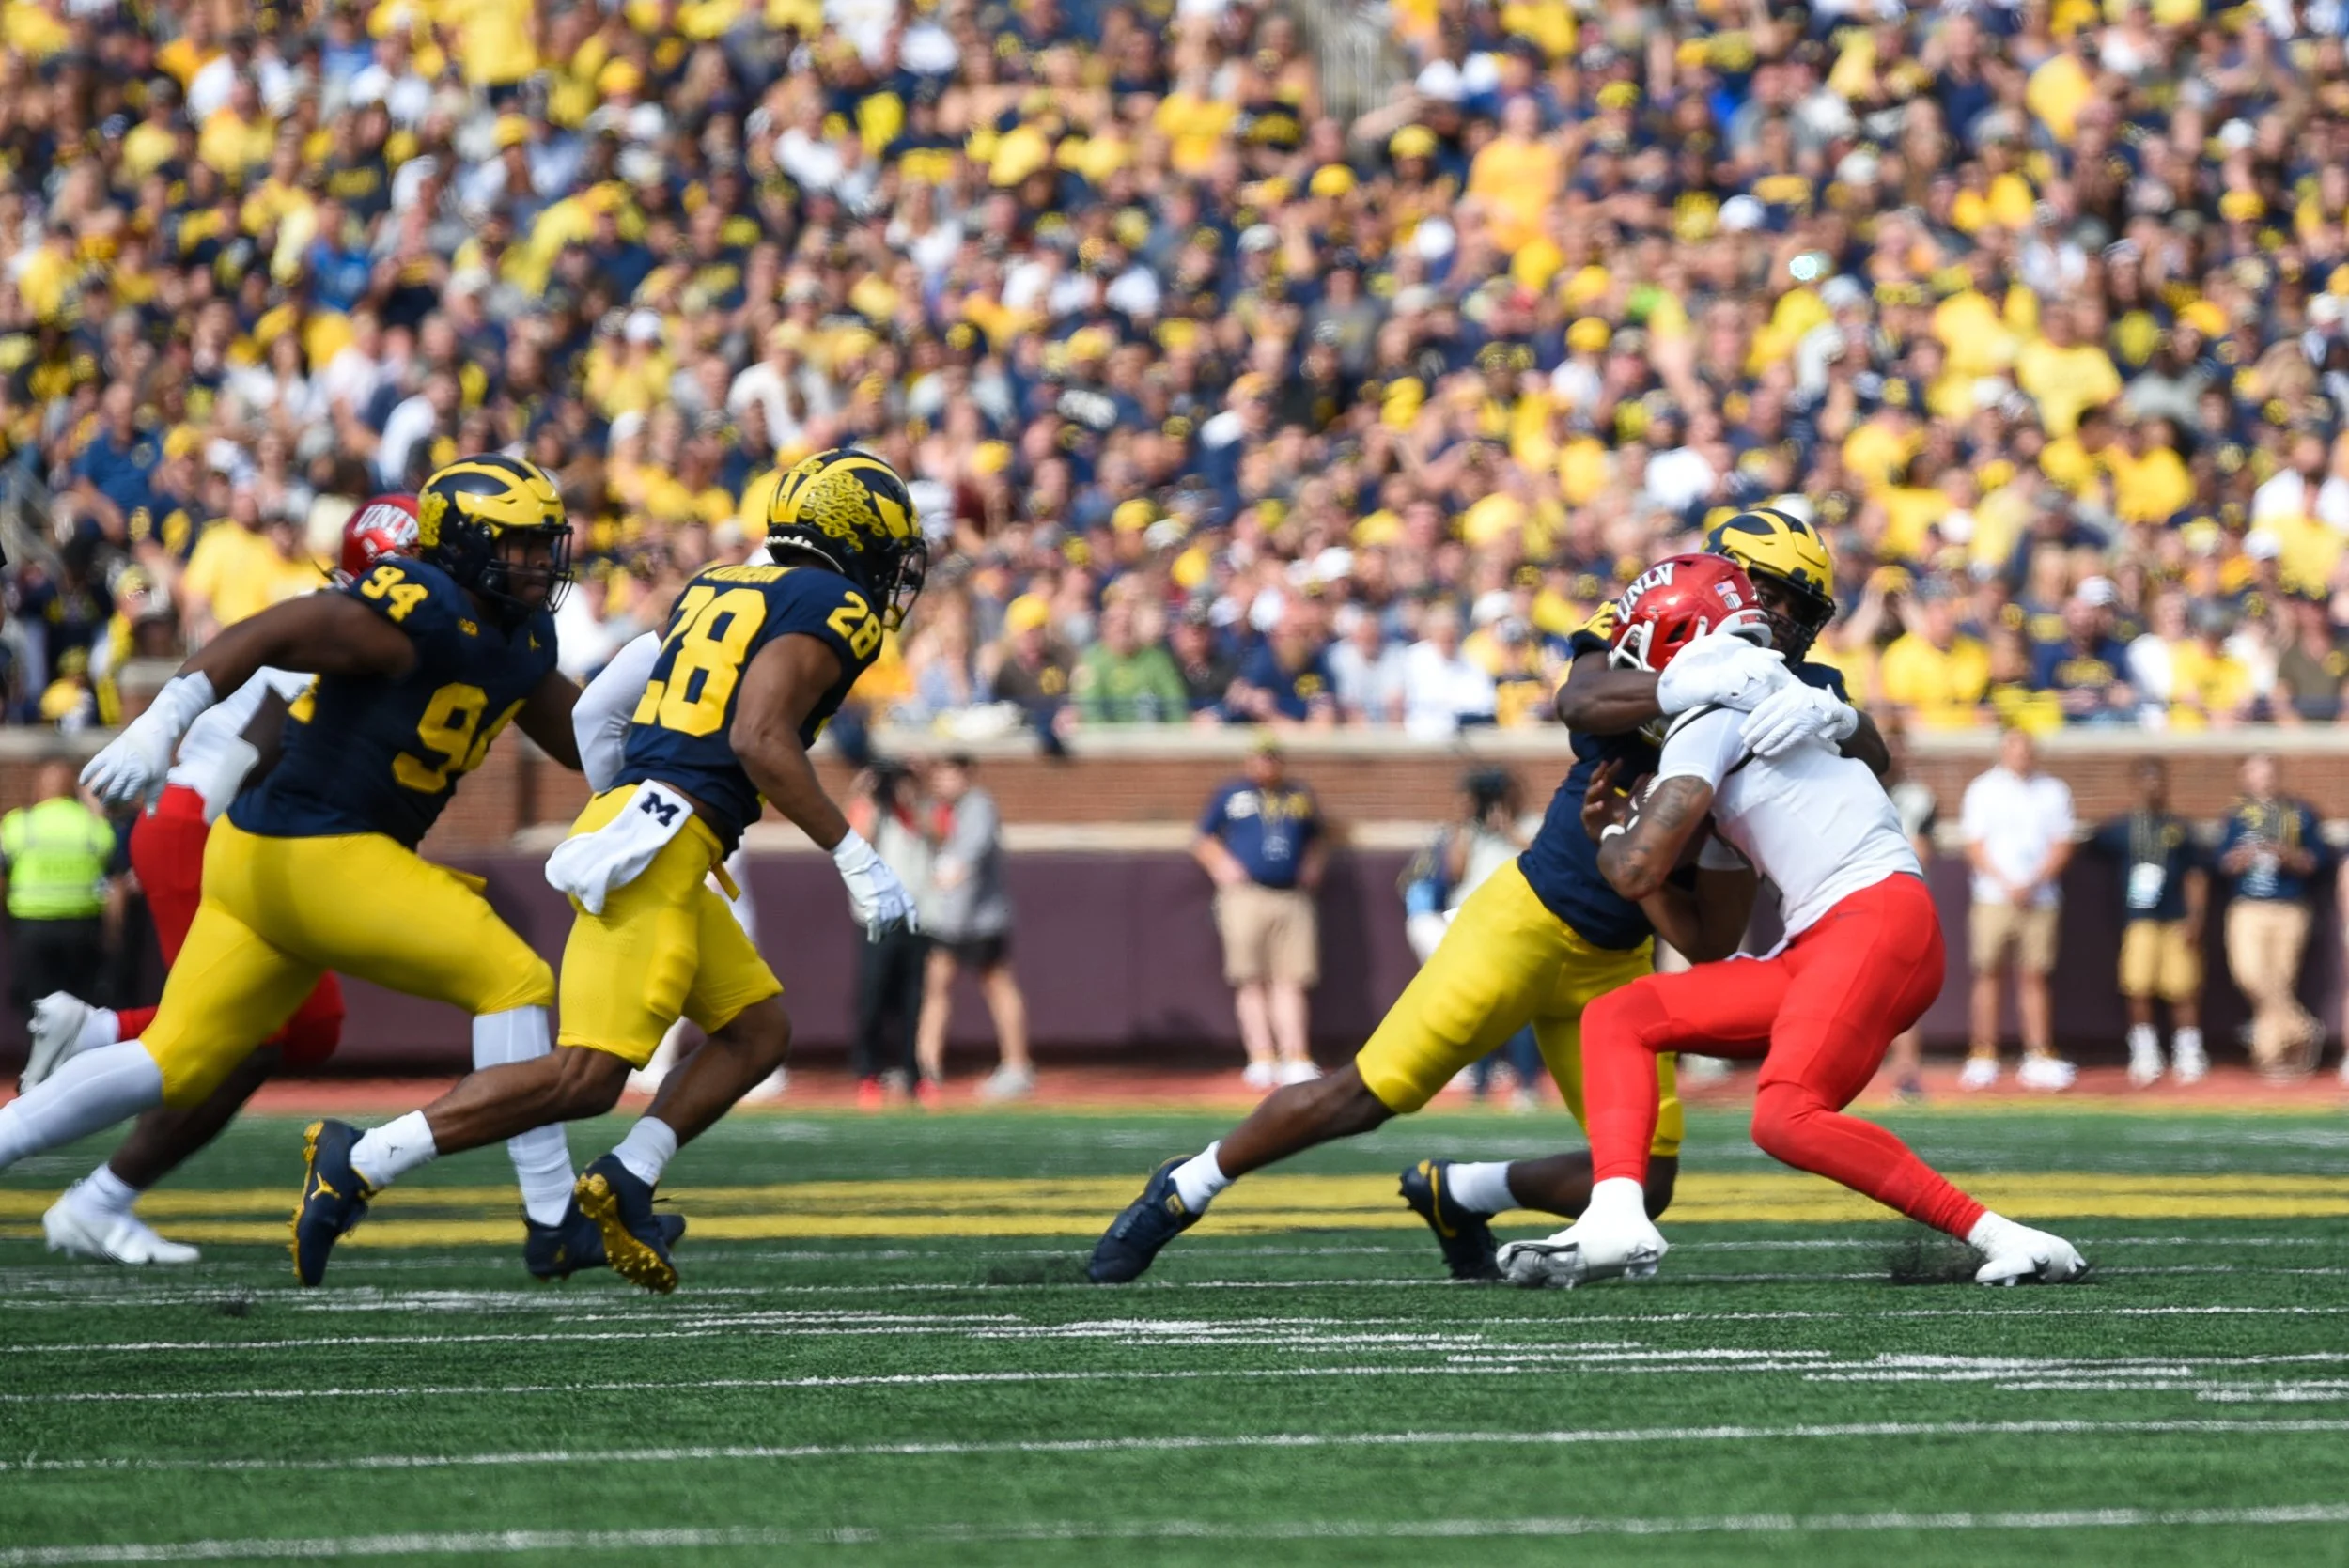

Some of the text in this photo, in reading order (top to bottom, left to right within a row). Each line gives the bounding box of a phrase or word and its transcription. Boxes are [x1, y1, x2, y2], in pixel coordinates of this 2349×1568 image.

[353, 503, 420, 546] UNLV
[360, 565, 429, 622] 94
[1616, 562, 1675, 625] UNLV
[827, 590, 883, 660] 28
[632, 584, 767, 737] 28
[639, 791, 680, 828] M
